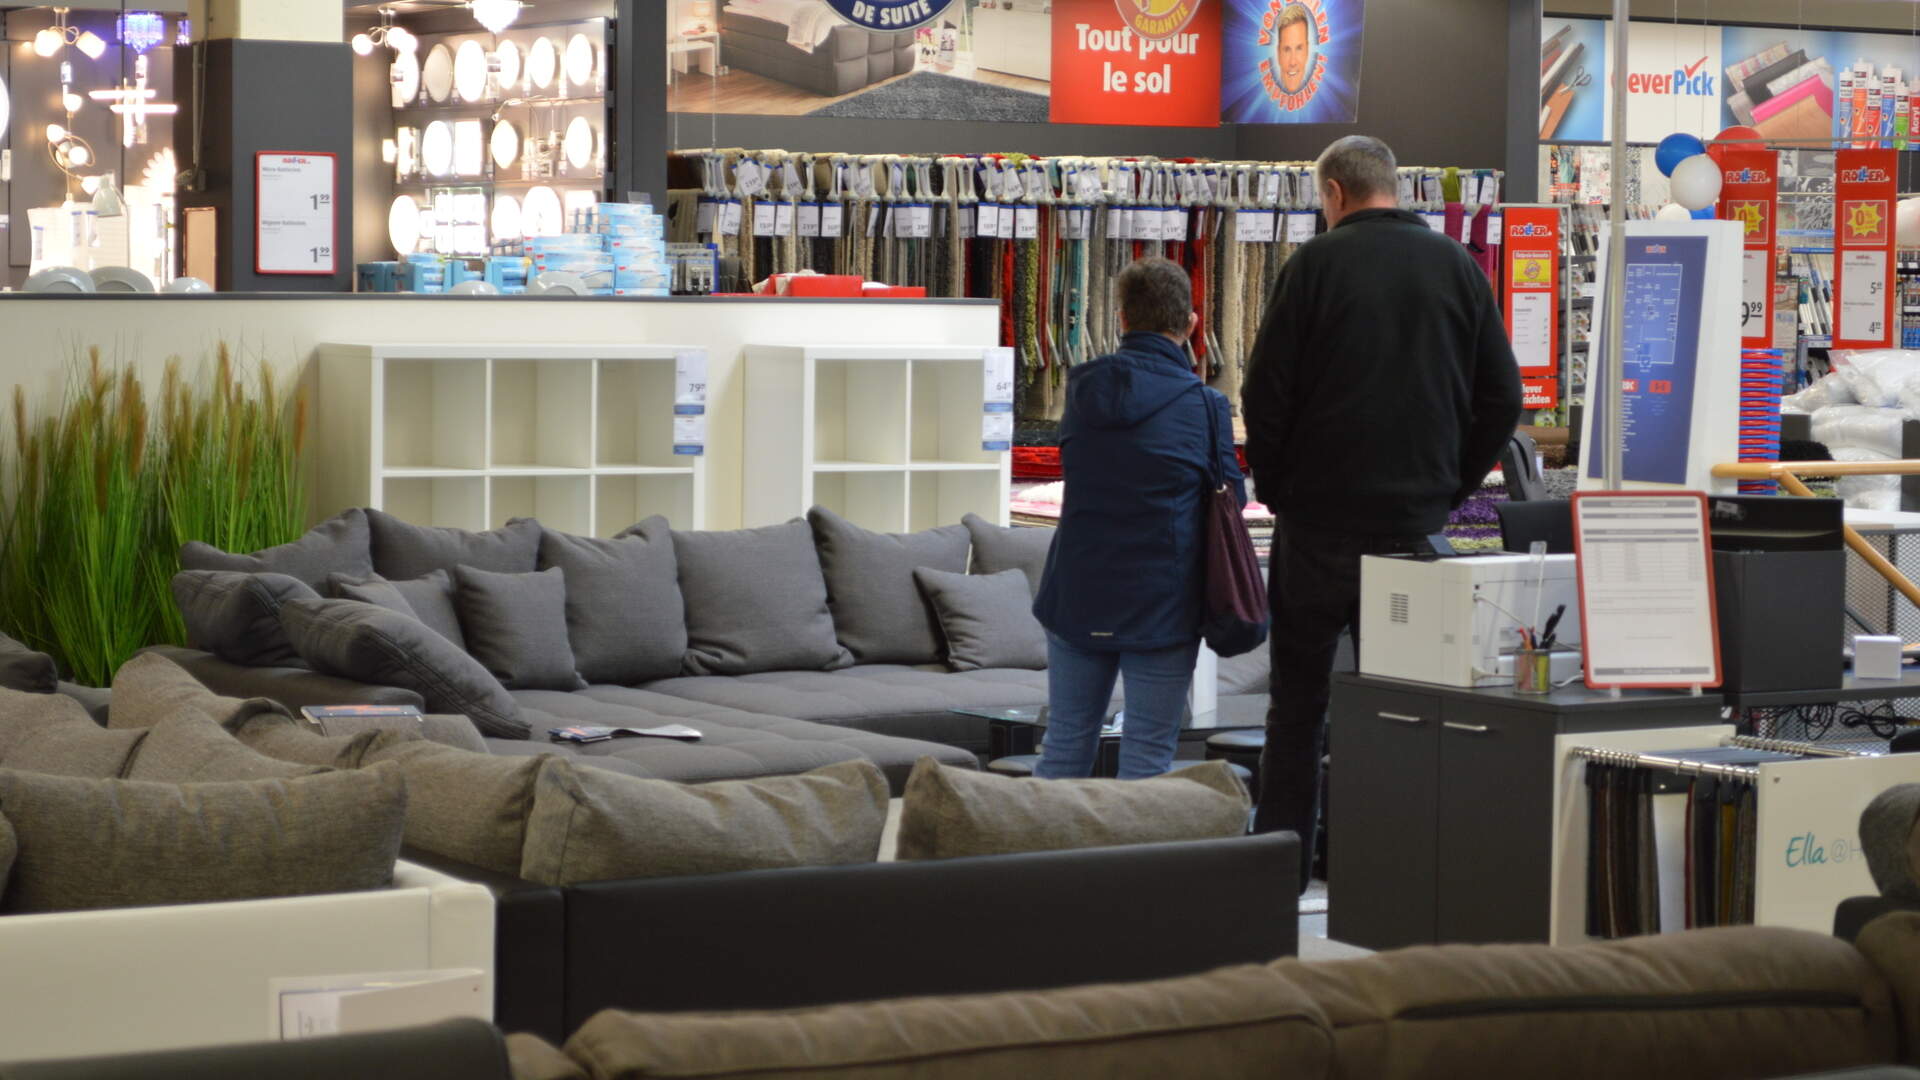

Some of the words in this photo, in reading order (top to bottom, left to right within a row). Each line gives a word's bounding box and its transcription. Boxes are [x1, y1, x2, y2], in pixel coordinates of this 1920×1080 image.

[852, 1, 875, 22] DE
[880, 0, 931, 25] SUITE
[1135, 2, 1190, 34] GARANTIE
[1075, 23, 1132, 52] Tout
[1139, 32, 1200, 60] pour
[1103, 61, 1128, 92] le
[1134, 63, 1171, 94] sol
[1611, 69, 1714, 96] everPick
